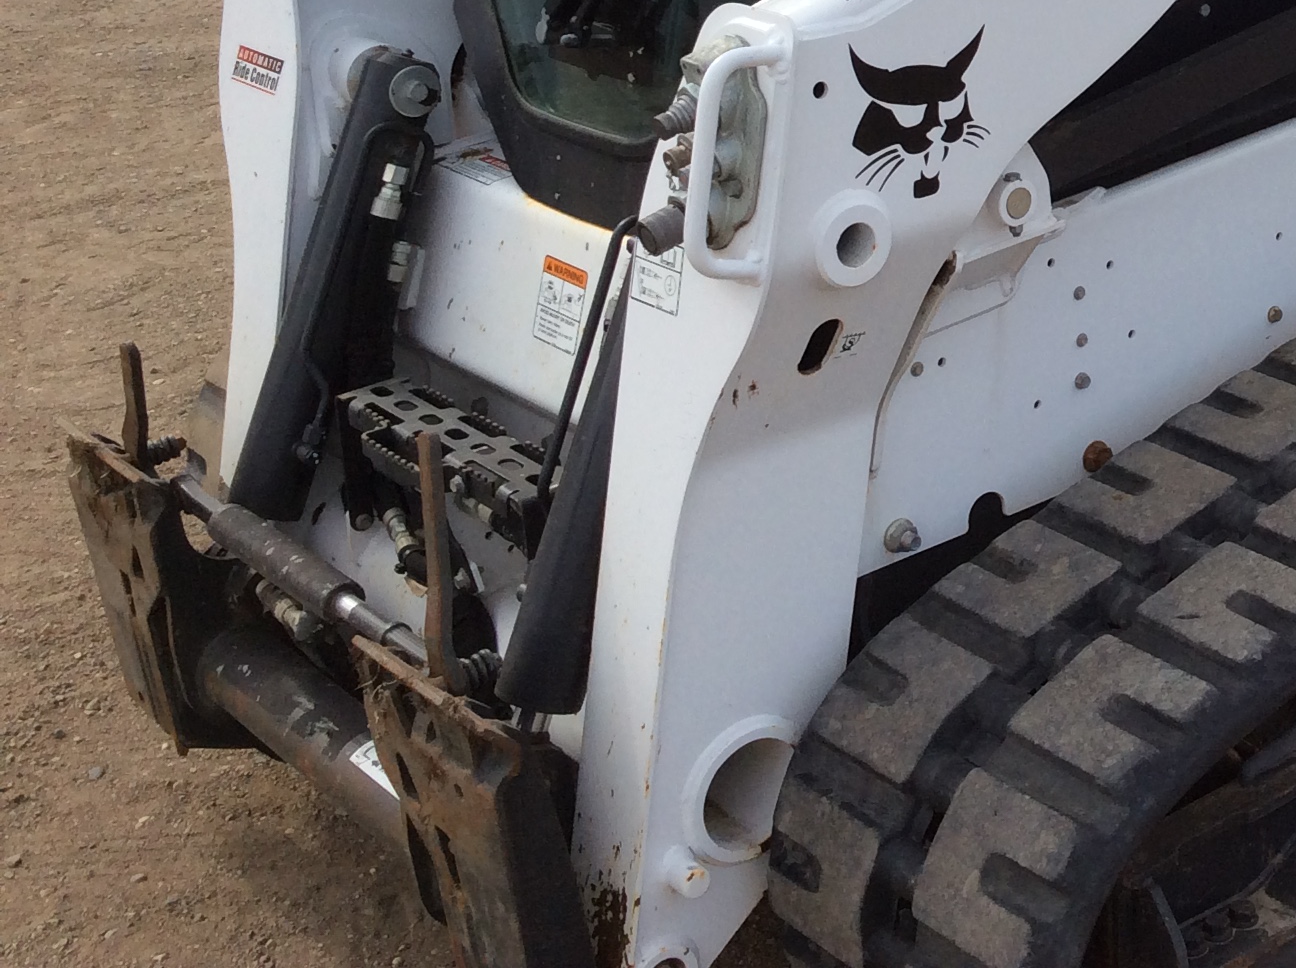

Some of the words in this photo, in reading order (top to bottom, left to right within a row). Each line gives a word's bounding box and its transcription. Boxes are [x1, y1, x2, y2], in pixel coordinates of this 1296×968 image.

[238, 48, 282, 72] AUTOMATIC
[232, 61, 250, 81] Ride
[250, 67, 280, 92] Control
